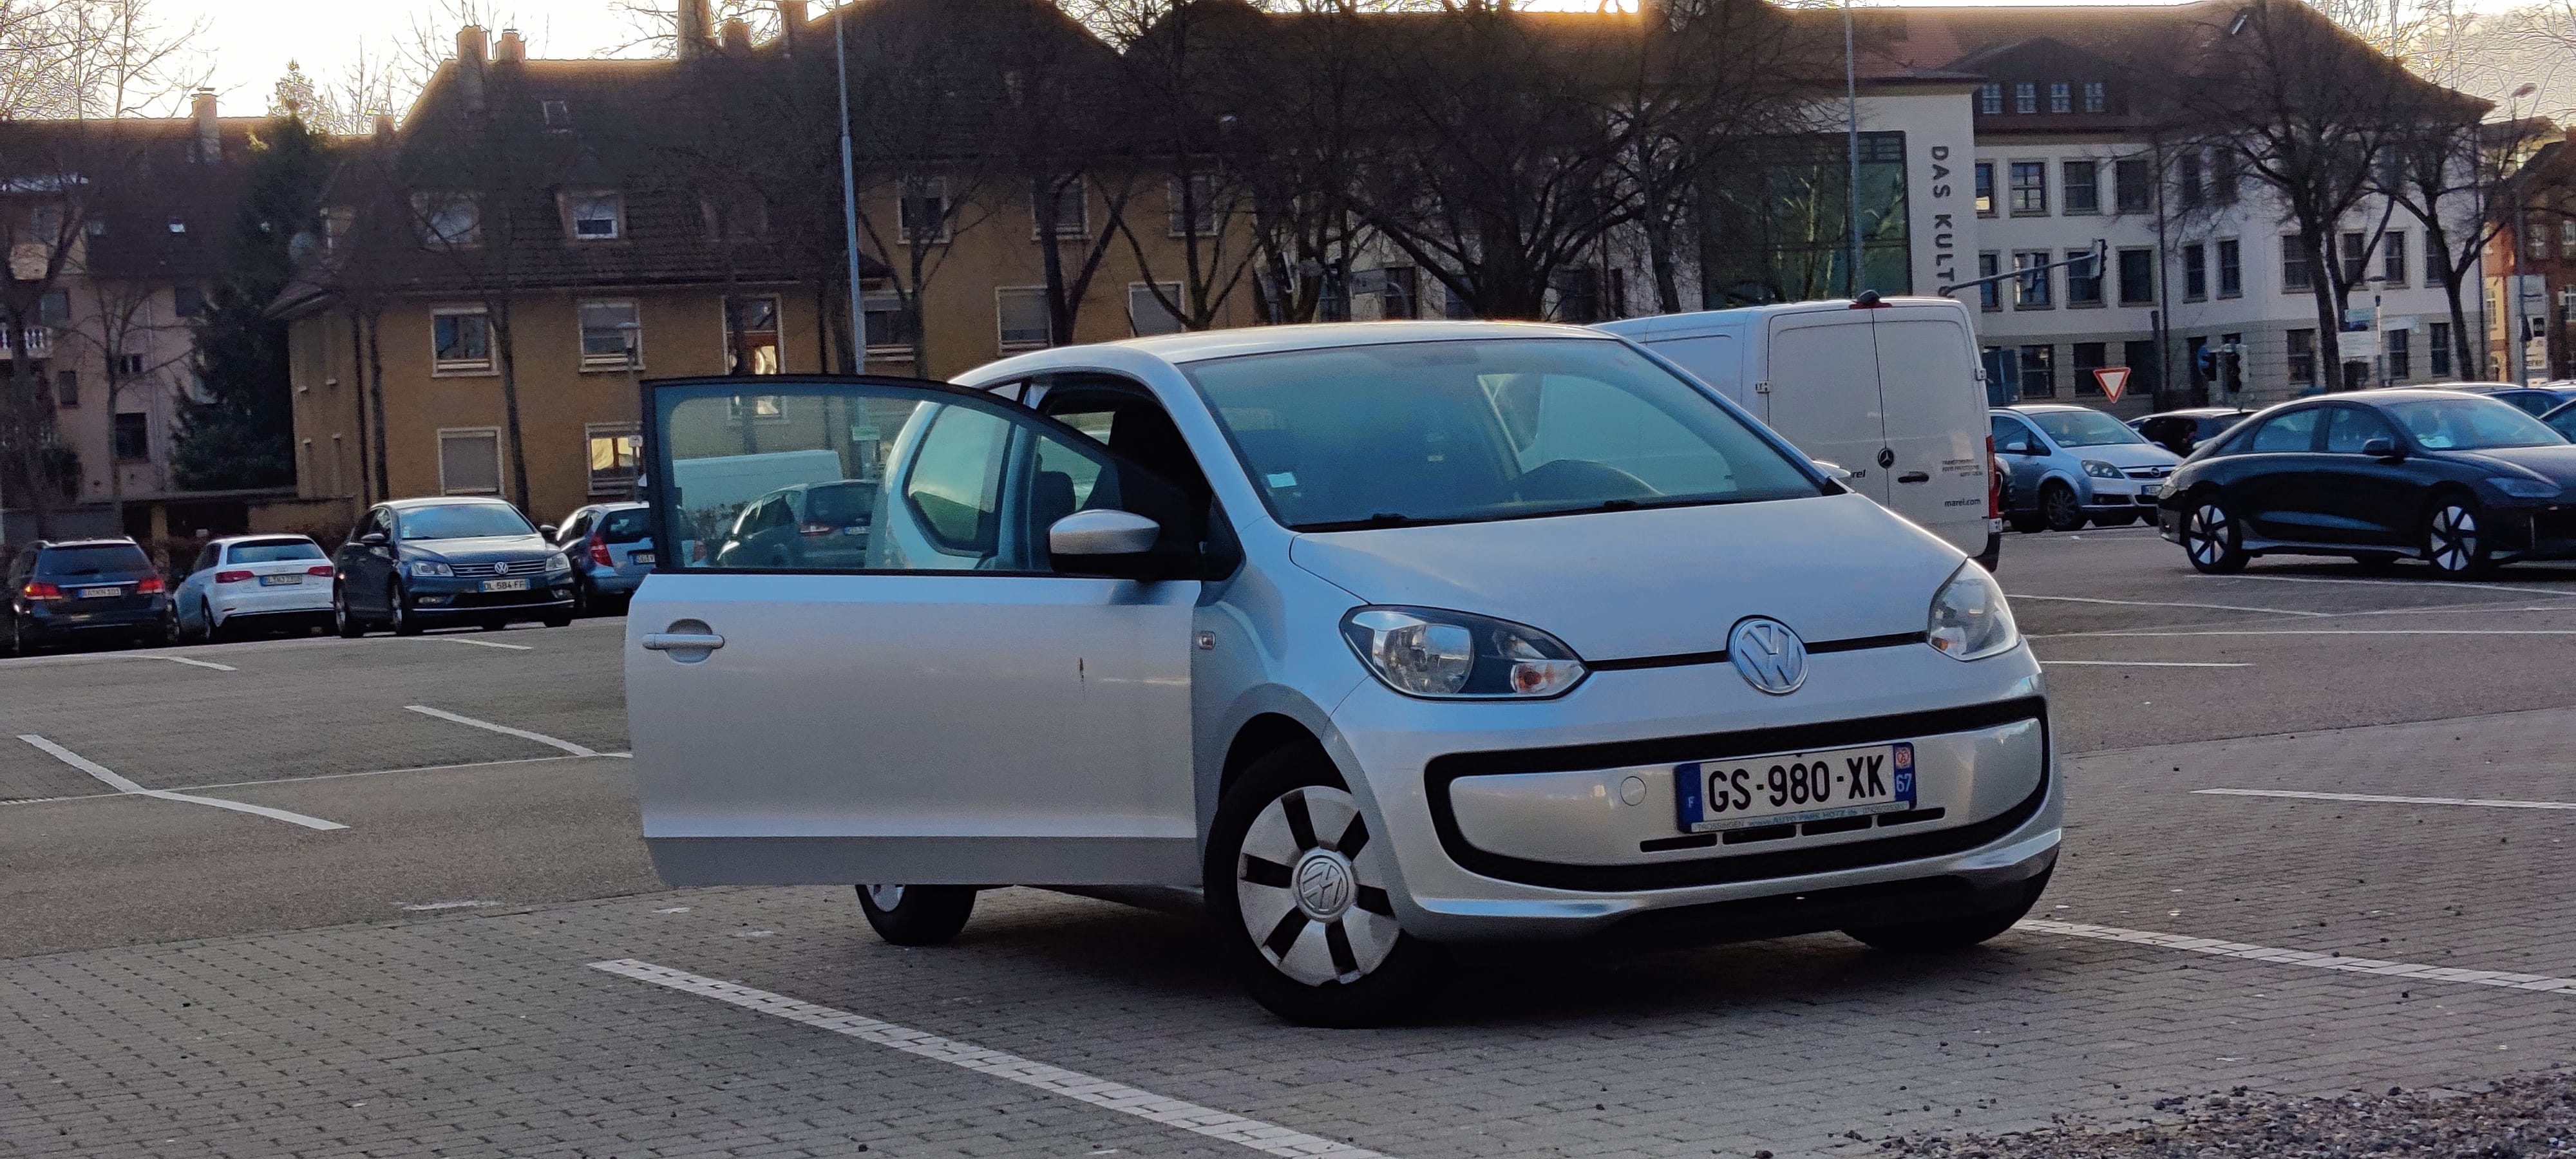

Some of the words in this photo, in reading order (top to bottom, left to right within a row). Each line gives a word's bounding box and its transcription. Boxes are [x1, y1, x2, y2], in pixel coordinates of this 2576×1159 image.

[1931, 146, 1951, 198] DAS
[1850, 469, 1866, 478] rel
[1944, 498, 1982, 507] marel.com
[1708, 754, 1886, 813] GS-980-XK
[1895, 773, 1912, 793] 67
[1687, 796, 1695, 808] F
